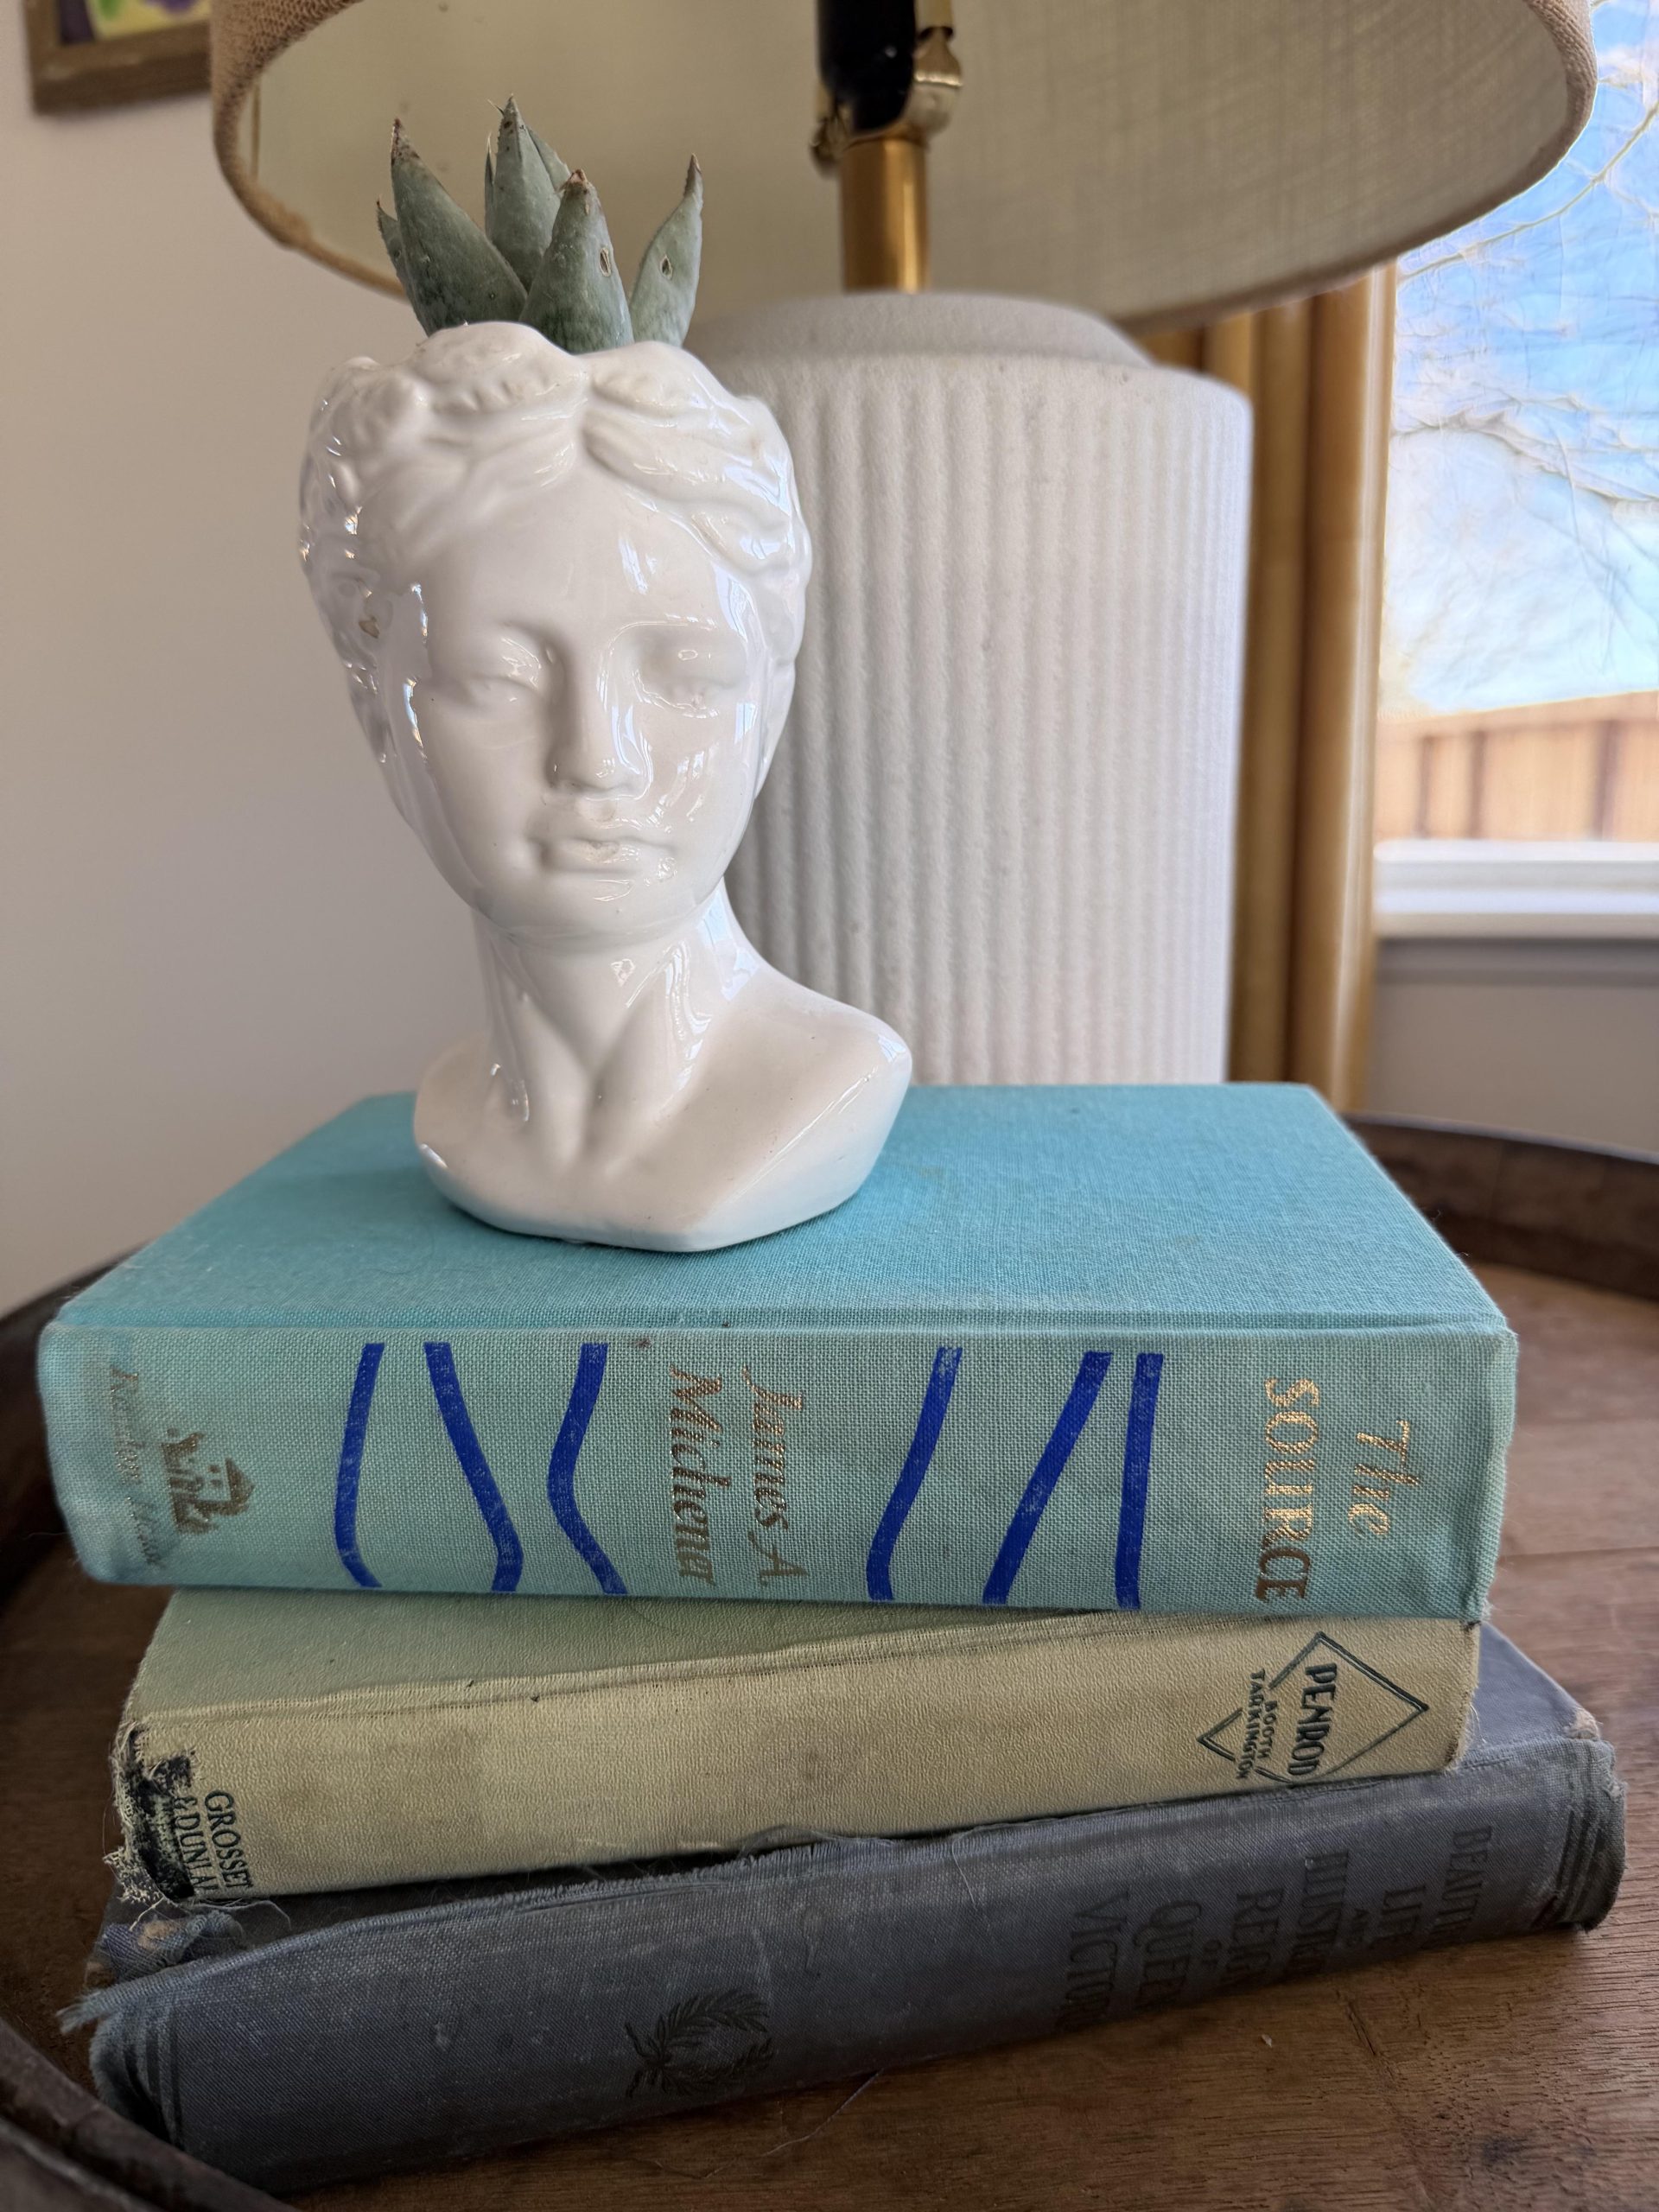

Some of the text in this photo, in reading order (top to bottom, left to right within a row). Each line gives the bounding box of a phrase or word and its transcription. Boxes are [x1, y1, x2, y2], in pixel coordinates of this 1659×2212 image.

[669, 1364, 732, 1588] Michener
[741, 1364, 804, 1530] James
[1255, 1376, 1320, 1604] SOURCE
[1346, 1418, 1421, 1538] The
[1236, 1668, 1266, 1779] TARKINGTON
[1256, 1700, 1278, 1759] BOOTH
[1287, 1662, 1338, 1776] PENROD
[173, 1796, 199, 1812] &
[204, 1789, 254, 1889] GROSSET
[1420, 1825, 1492, 1951] BEAUTI
[1054, 1885, 1130, 2034] VICTOR
